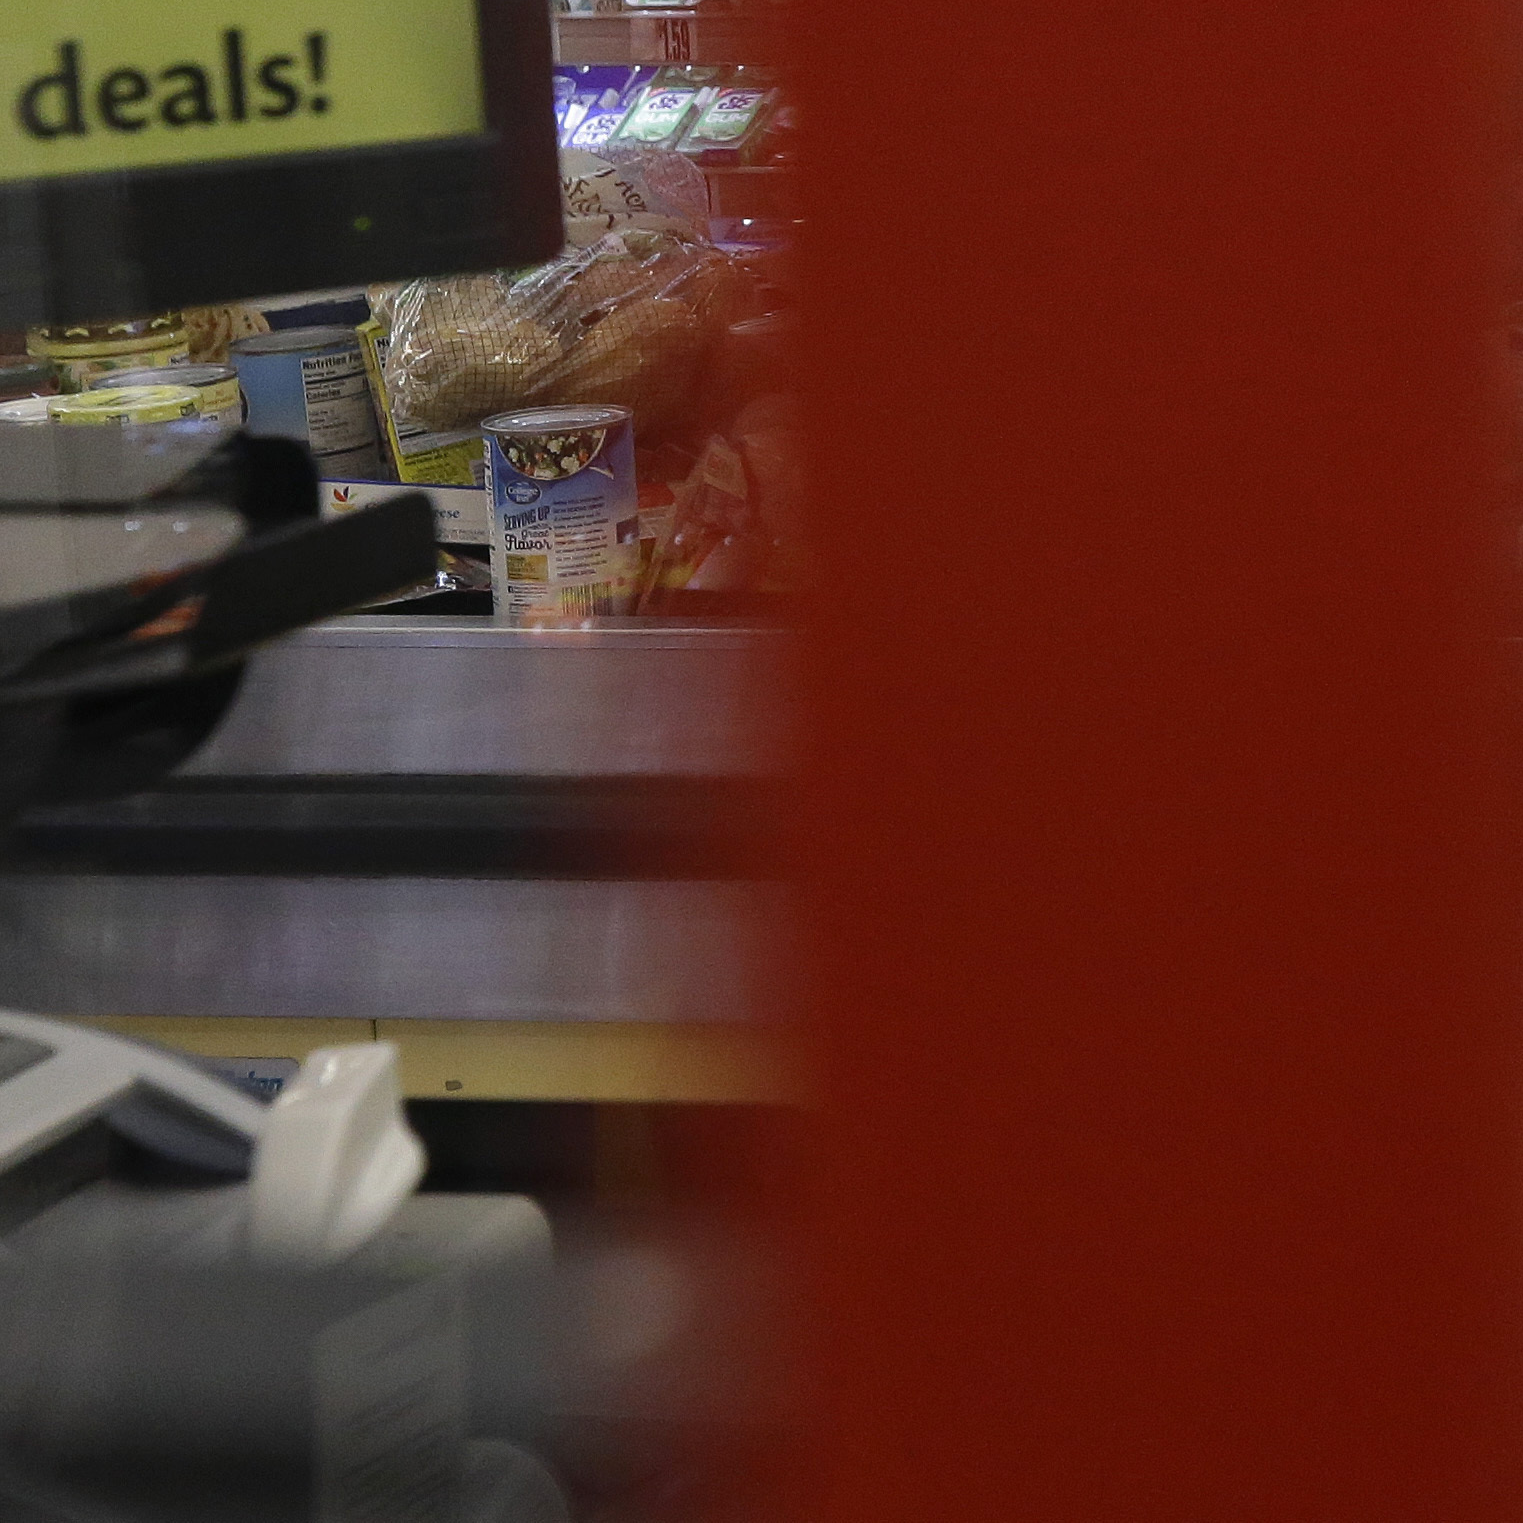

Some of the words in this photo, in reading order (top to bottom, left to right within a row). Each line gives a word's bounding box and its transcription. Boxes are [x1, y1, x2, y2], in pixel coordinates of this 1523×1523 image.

[17, 28, 330, 141] deals!
[503, 507, 537, 529] SERVING
[537, 505, 551, 521] UP
[504, 533, 553, 551] Flavor
